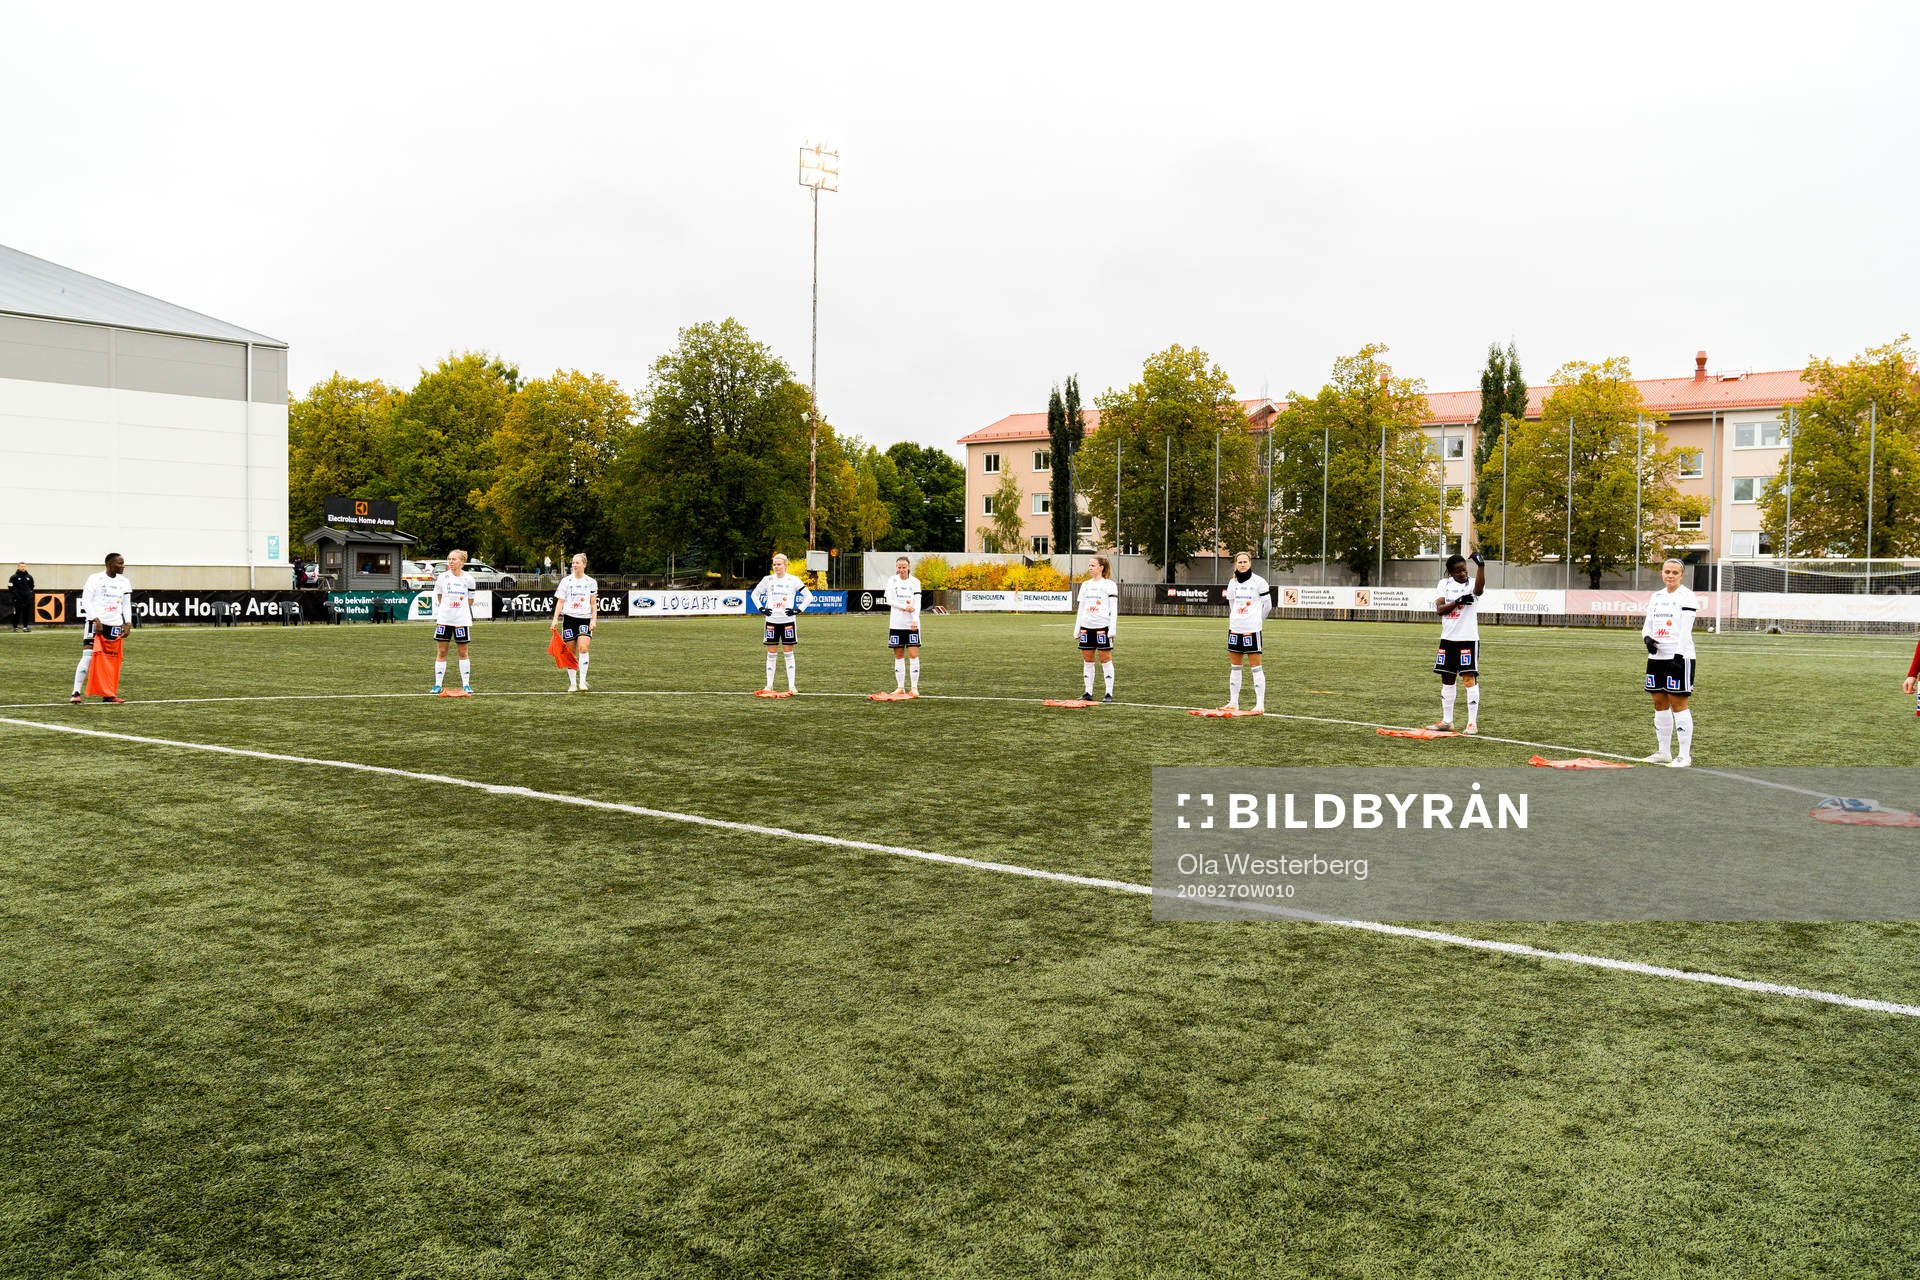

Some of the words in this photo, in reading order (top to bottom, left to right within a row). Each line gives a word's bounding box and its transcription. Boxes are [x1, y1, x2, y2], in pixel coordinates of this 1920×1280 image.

[328, 514, 357, 524] Electrolux
[359, 517, 376, 525] Home
[377, 518, 395, 526] Arena
[1176, 588, 1208, 597] valutec
[334, 596, 344, 604] Bo
[662, 596, 718, 610] LOGART
[246, 597, 300, 616] Area
[1503, 603, 1549, 612] TRELLEBORG
